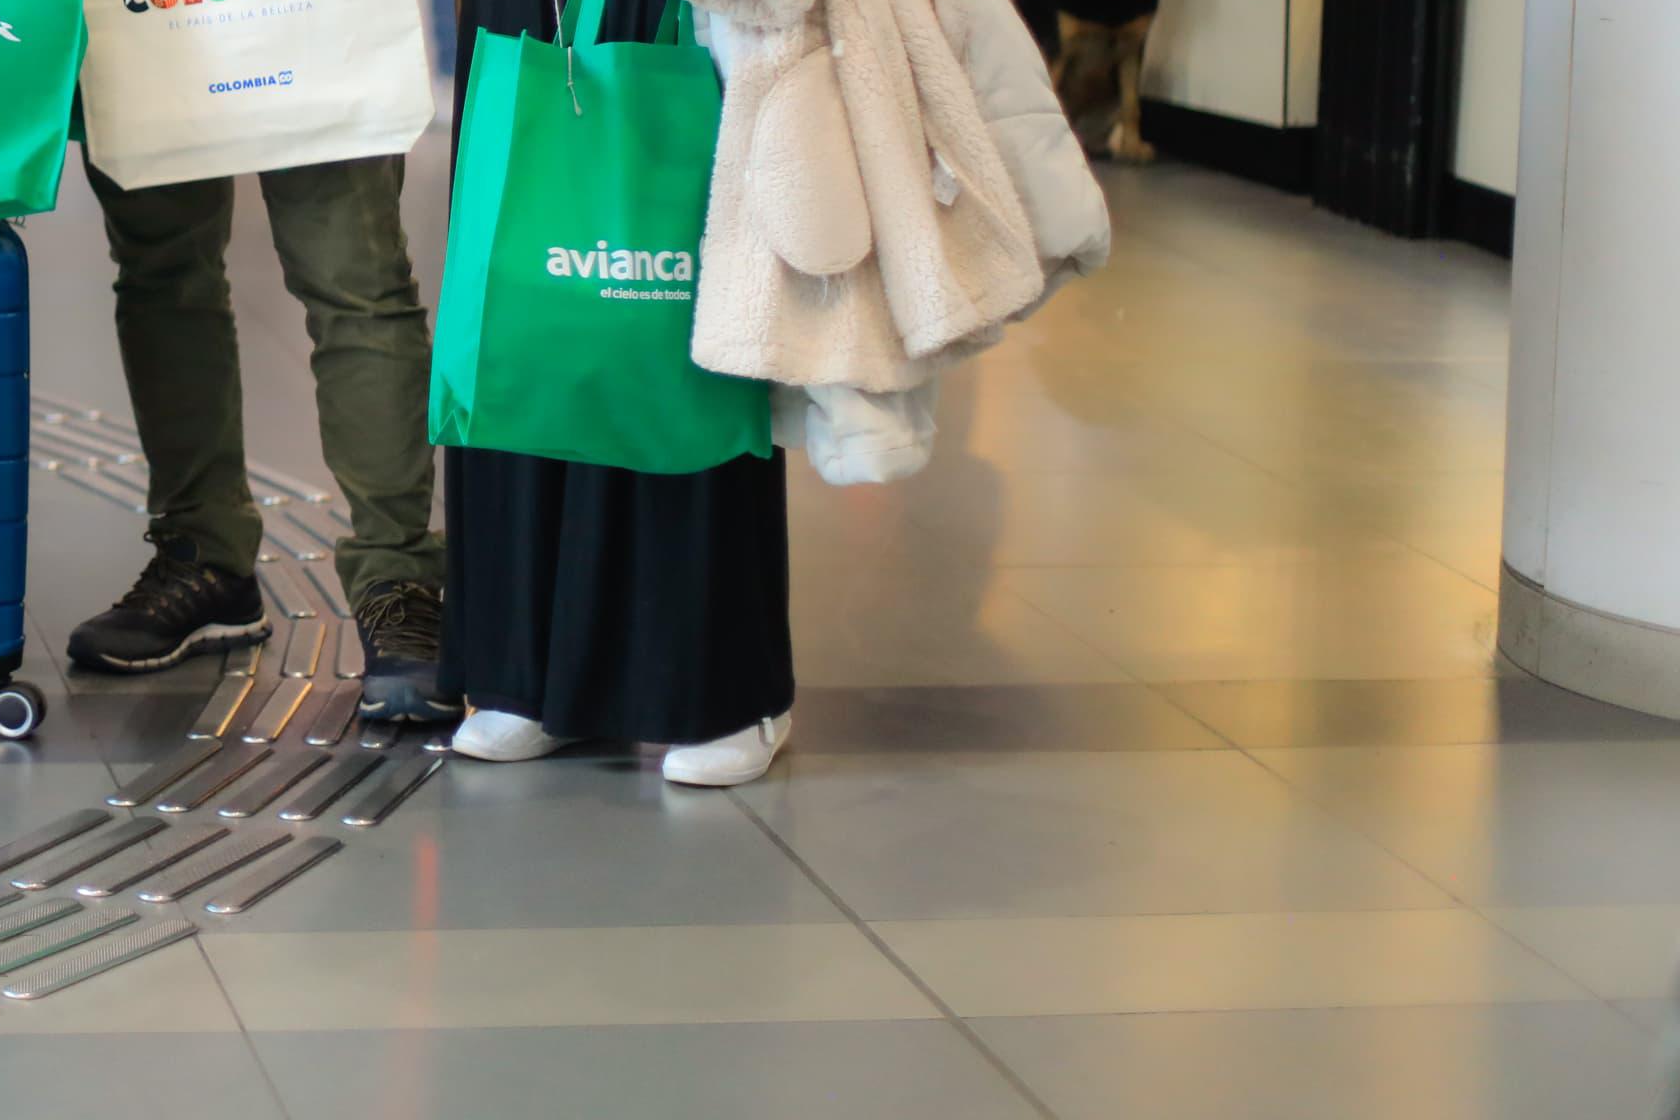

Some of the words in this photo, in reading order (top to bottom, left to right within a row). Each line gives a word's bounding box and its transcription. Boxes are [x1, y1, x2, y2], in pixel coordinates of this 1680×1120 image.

[208, 75, 277, 93] COLOMBIA
[546, 240, 693, 281] avianca
[600, 287, 611, 298] el
[612, 288, 638, 299] cielo
[639, 290, 651, 299] es
[651, 289, 664, 300] de
[664, 289, 691, 300] todos
